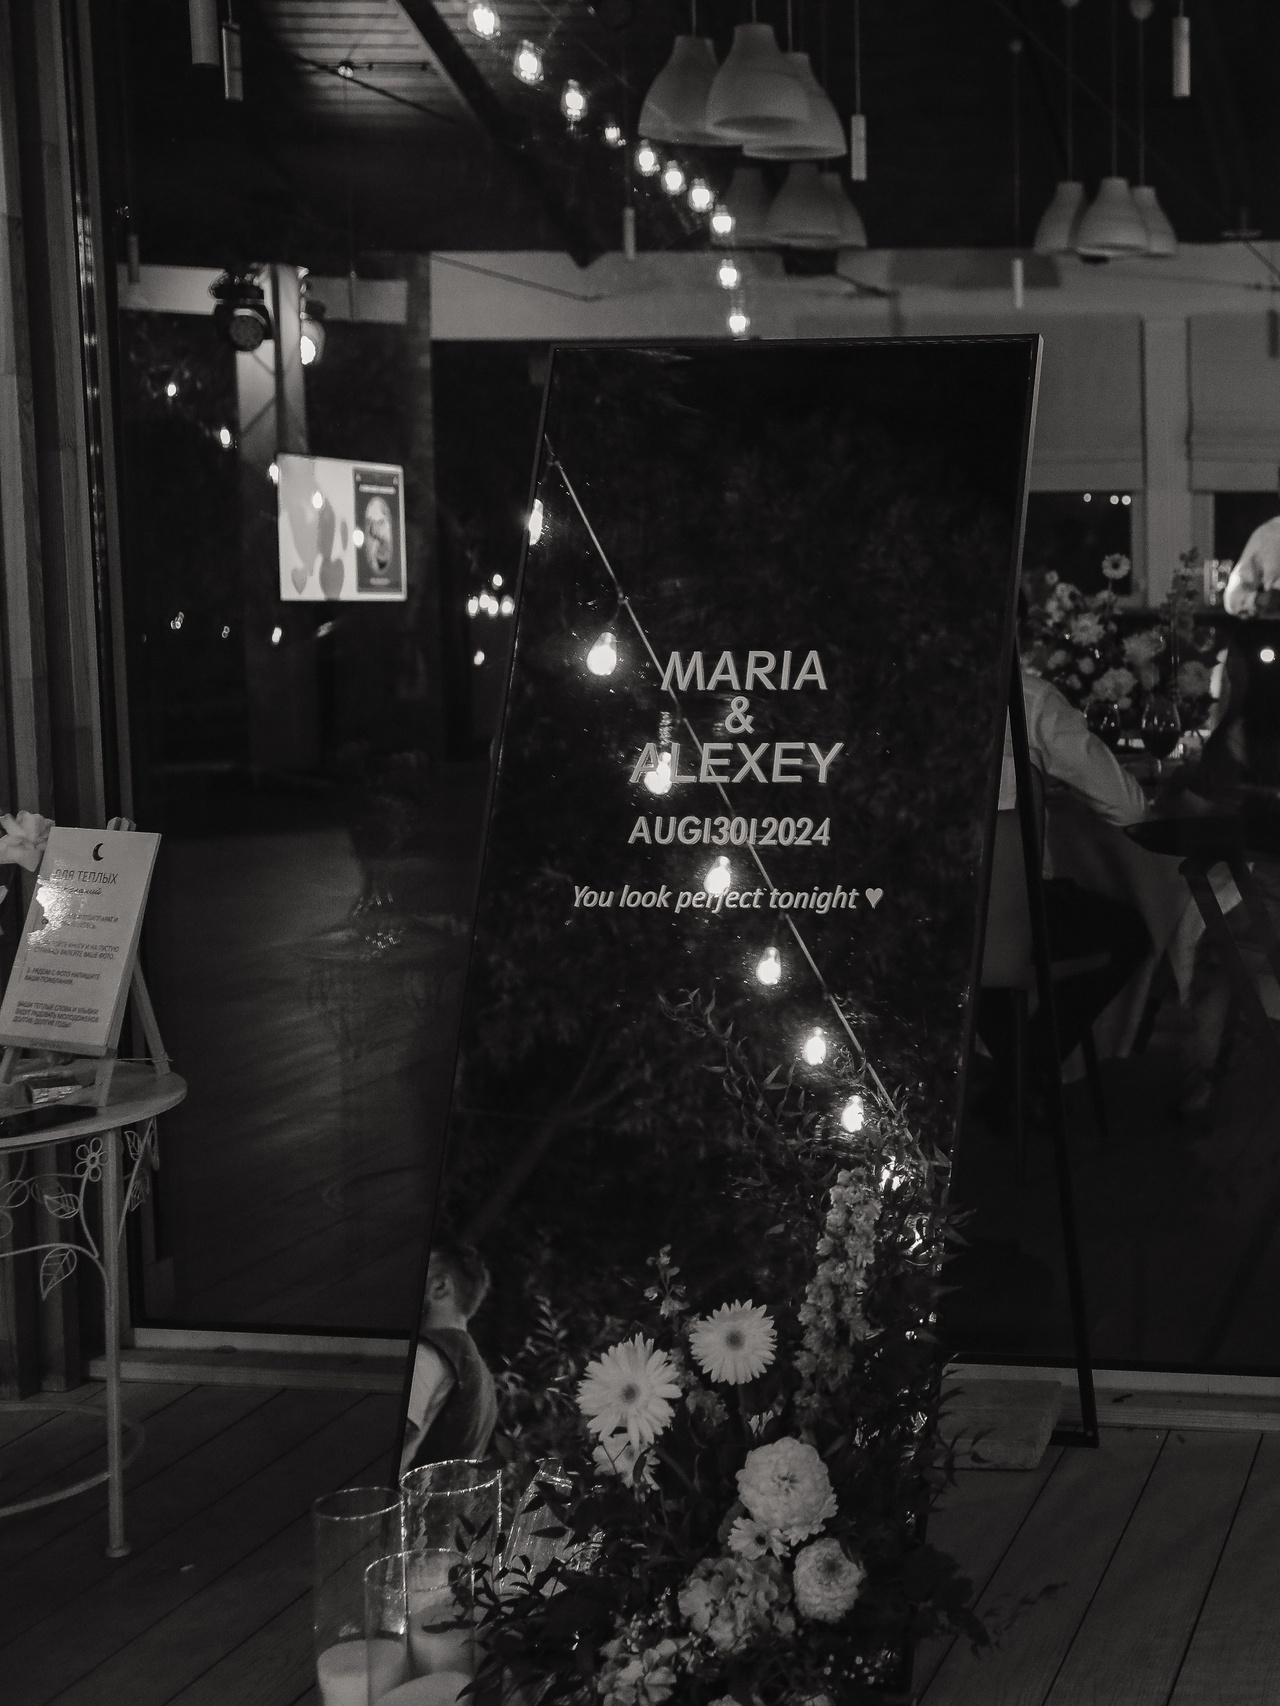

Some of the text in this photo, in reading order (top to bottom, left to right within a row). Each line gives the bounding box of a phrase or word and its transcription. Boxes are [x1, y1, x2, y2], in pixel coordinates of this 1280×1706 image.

[661, 650, 828, 691] MARIA
[724, 696, 755, 735] &
[629, 741, 845, 784] ALEXEY
[77, 870, 119, 885] ТЕПЛЫХ
[573, 884, 860, 914] You look perfect tonight
